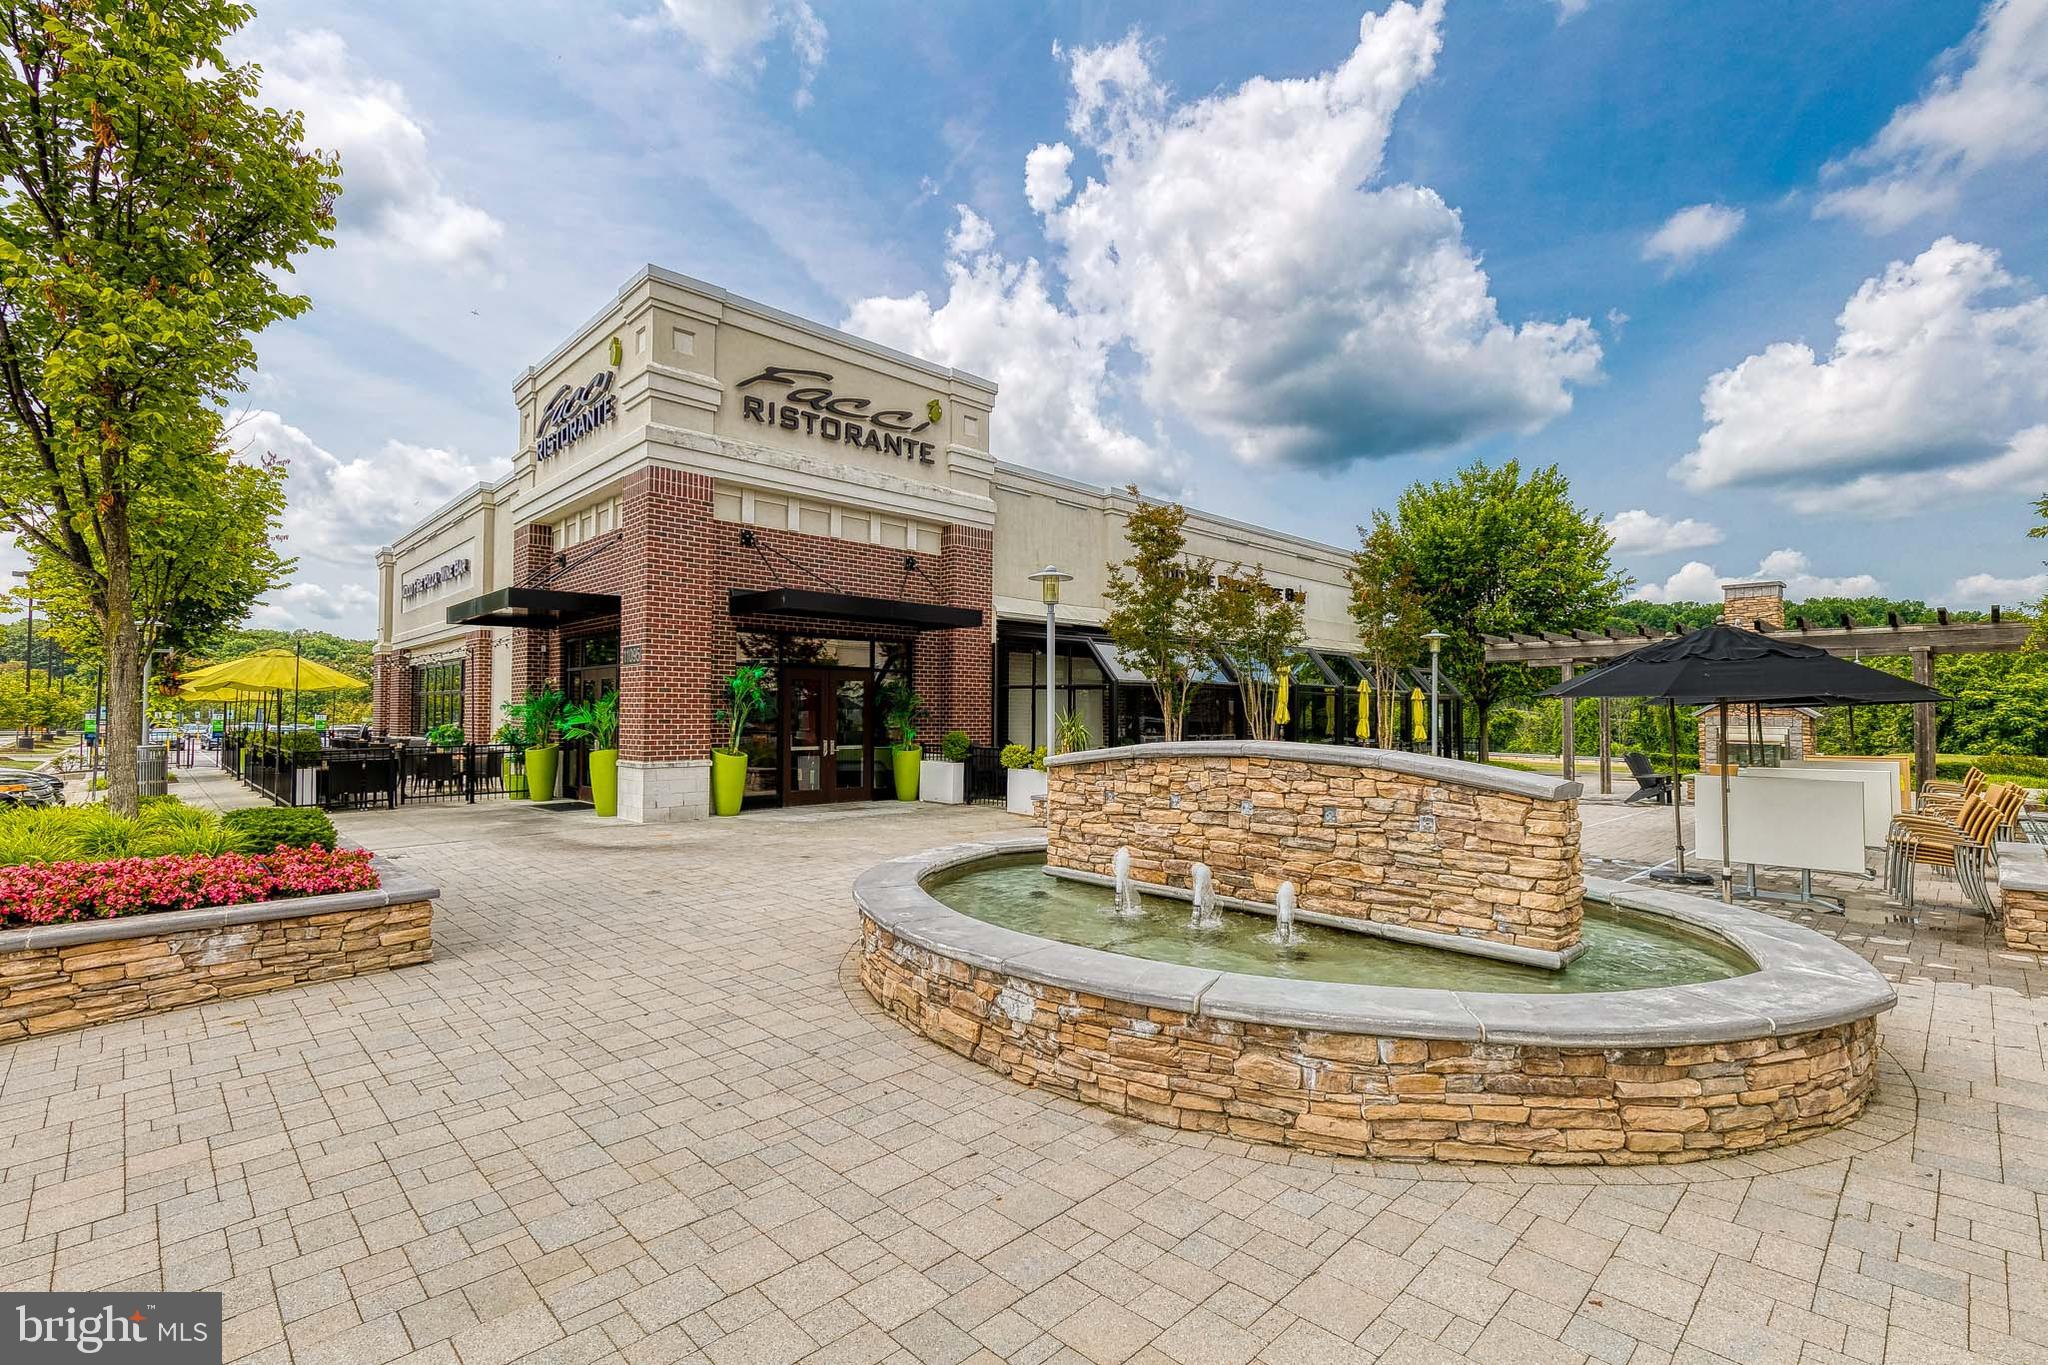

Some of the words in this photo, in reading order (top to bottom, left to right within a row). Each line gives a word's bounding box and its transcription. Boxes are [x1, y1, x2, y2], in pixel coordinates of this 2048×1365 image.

[537, 394, 617, 461] RISTORANTE
[736, 367, 942, 432] Facci
[744, 395, 935, 464] RISTORANTE
